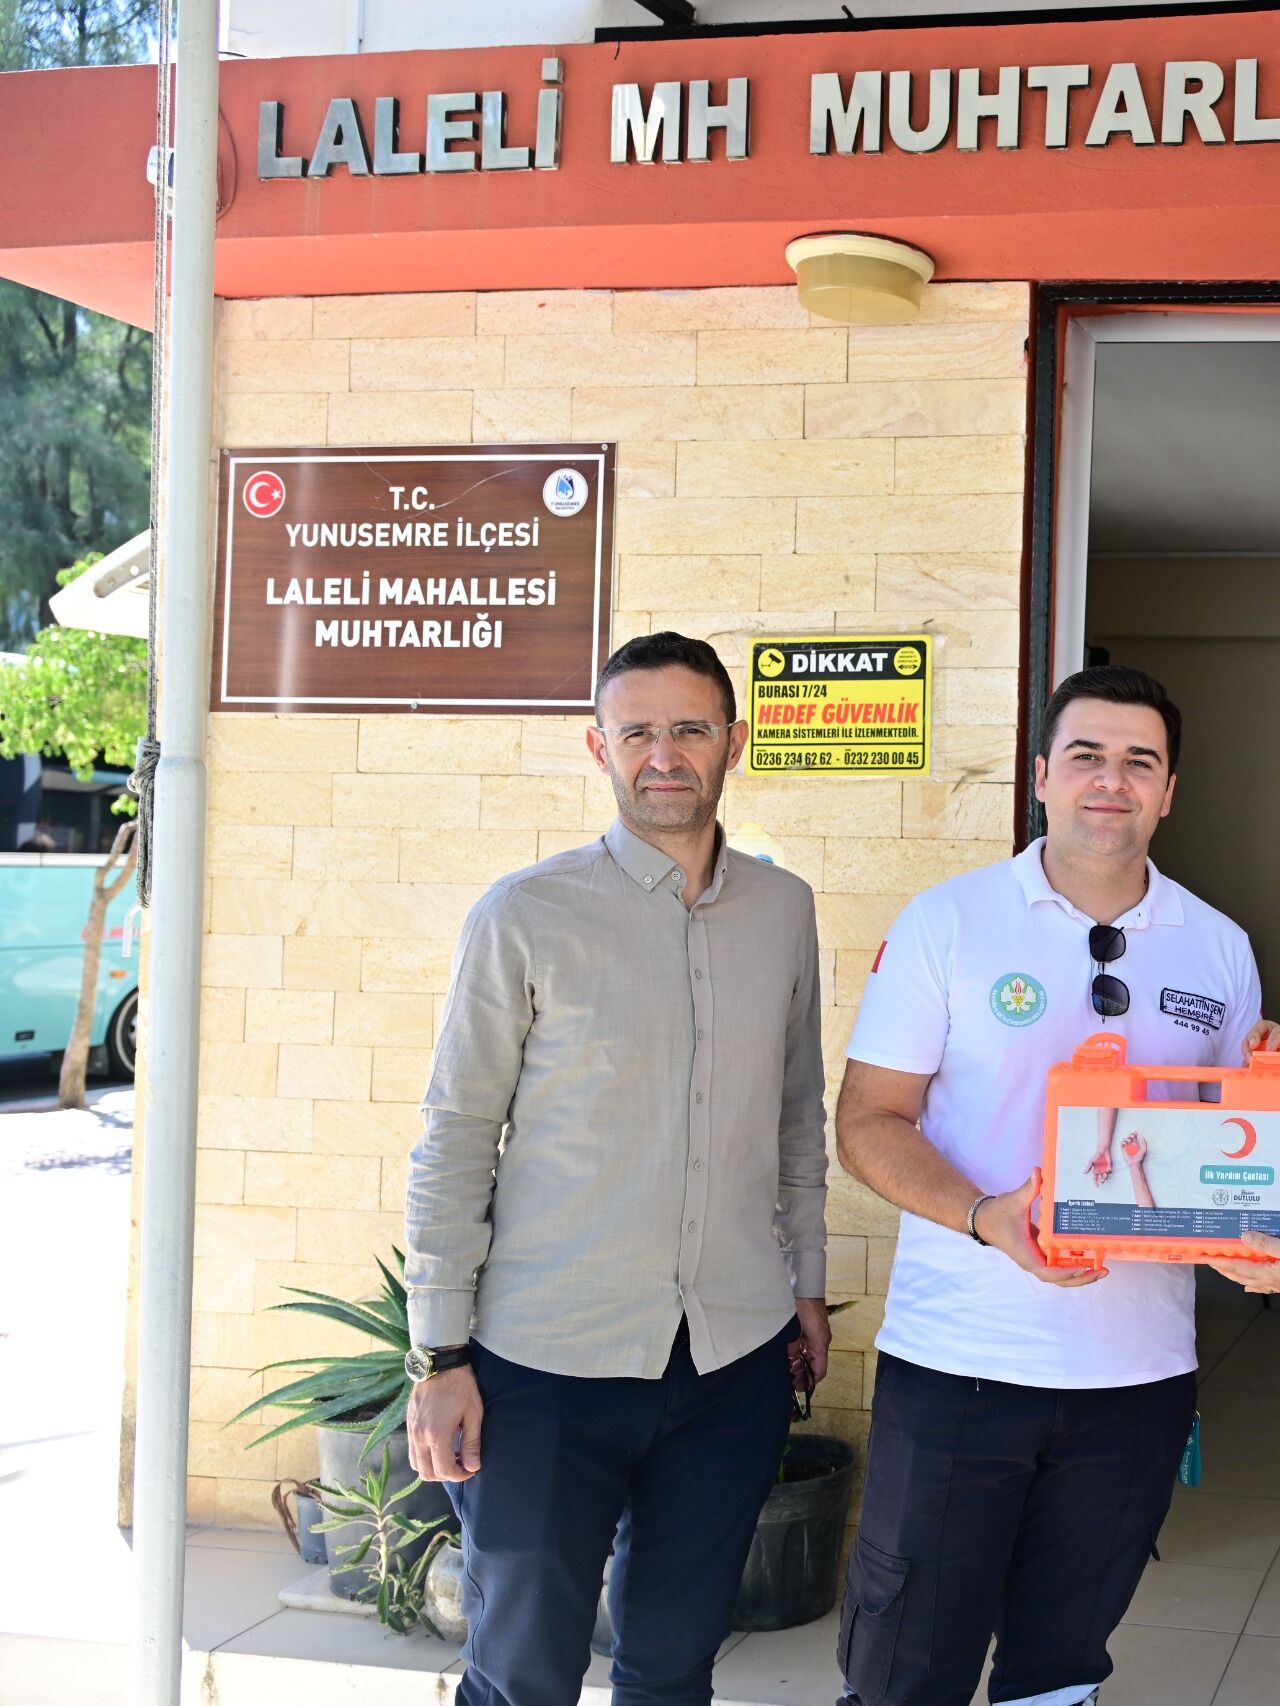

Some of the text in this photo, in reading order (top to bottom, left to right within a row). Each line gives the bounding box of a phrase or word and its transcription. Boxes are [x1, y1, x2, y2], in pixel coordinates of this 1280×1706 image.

[258, 58, 562, 180] LALELİ
[610, 77, 748, 164] MH
[389, 486, 435, 511] T.C.
[285, 517, 539, 553] YUNUSEMRE İLÇESİ
[266, 571, 556, 606] LALELİ MAHALLESİ
[315, 612, 502, 648] MUHTARLIĞI
[792, 650, 888, 673] DİKKAT
[758, 684, 827, 698] BURASI 7/24
[757, 697, 919, 724] HEDEF GÜVENLİK
[757, 726, 919, 739] KAMERA SİSTEMLERİ İLE İZLENMEKTEDİR.
[756, 752, 782, 766] 0236
[784, 752, 802, 765] 234
[805, 752, 817, 765] 62
[819, 752, 832, 765] 62
[844, 752, 869, 765] 0232
[871, 752, 889, 765] 230
[892, 752, 904, 765] 00
[906, 752, 919, 765] 45
[1174, 1019, 1210, 1036] 444 99 45
[1216, 1171, 1241, 1180] Yardım
[1243, 1171, 1269, 1182] Çantası
